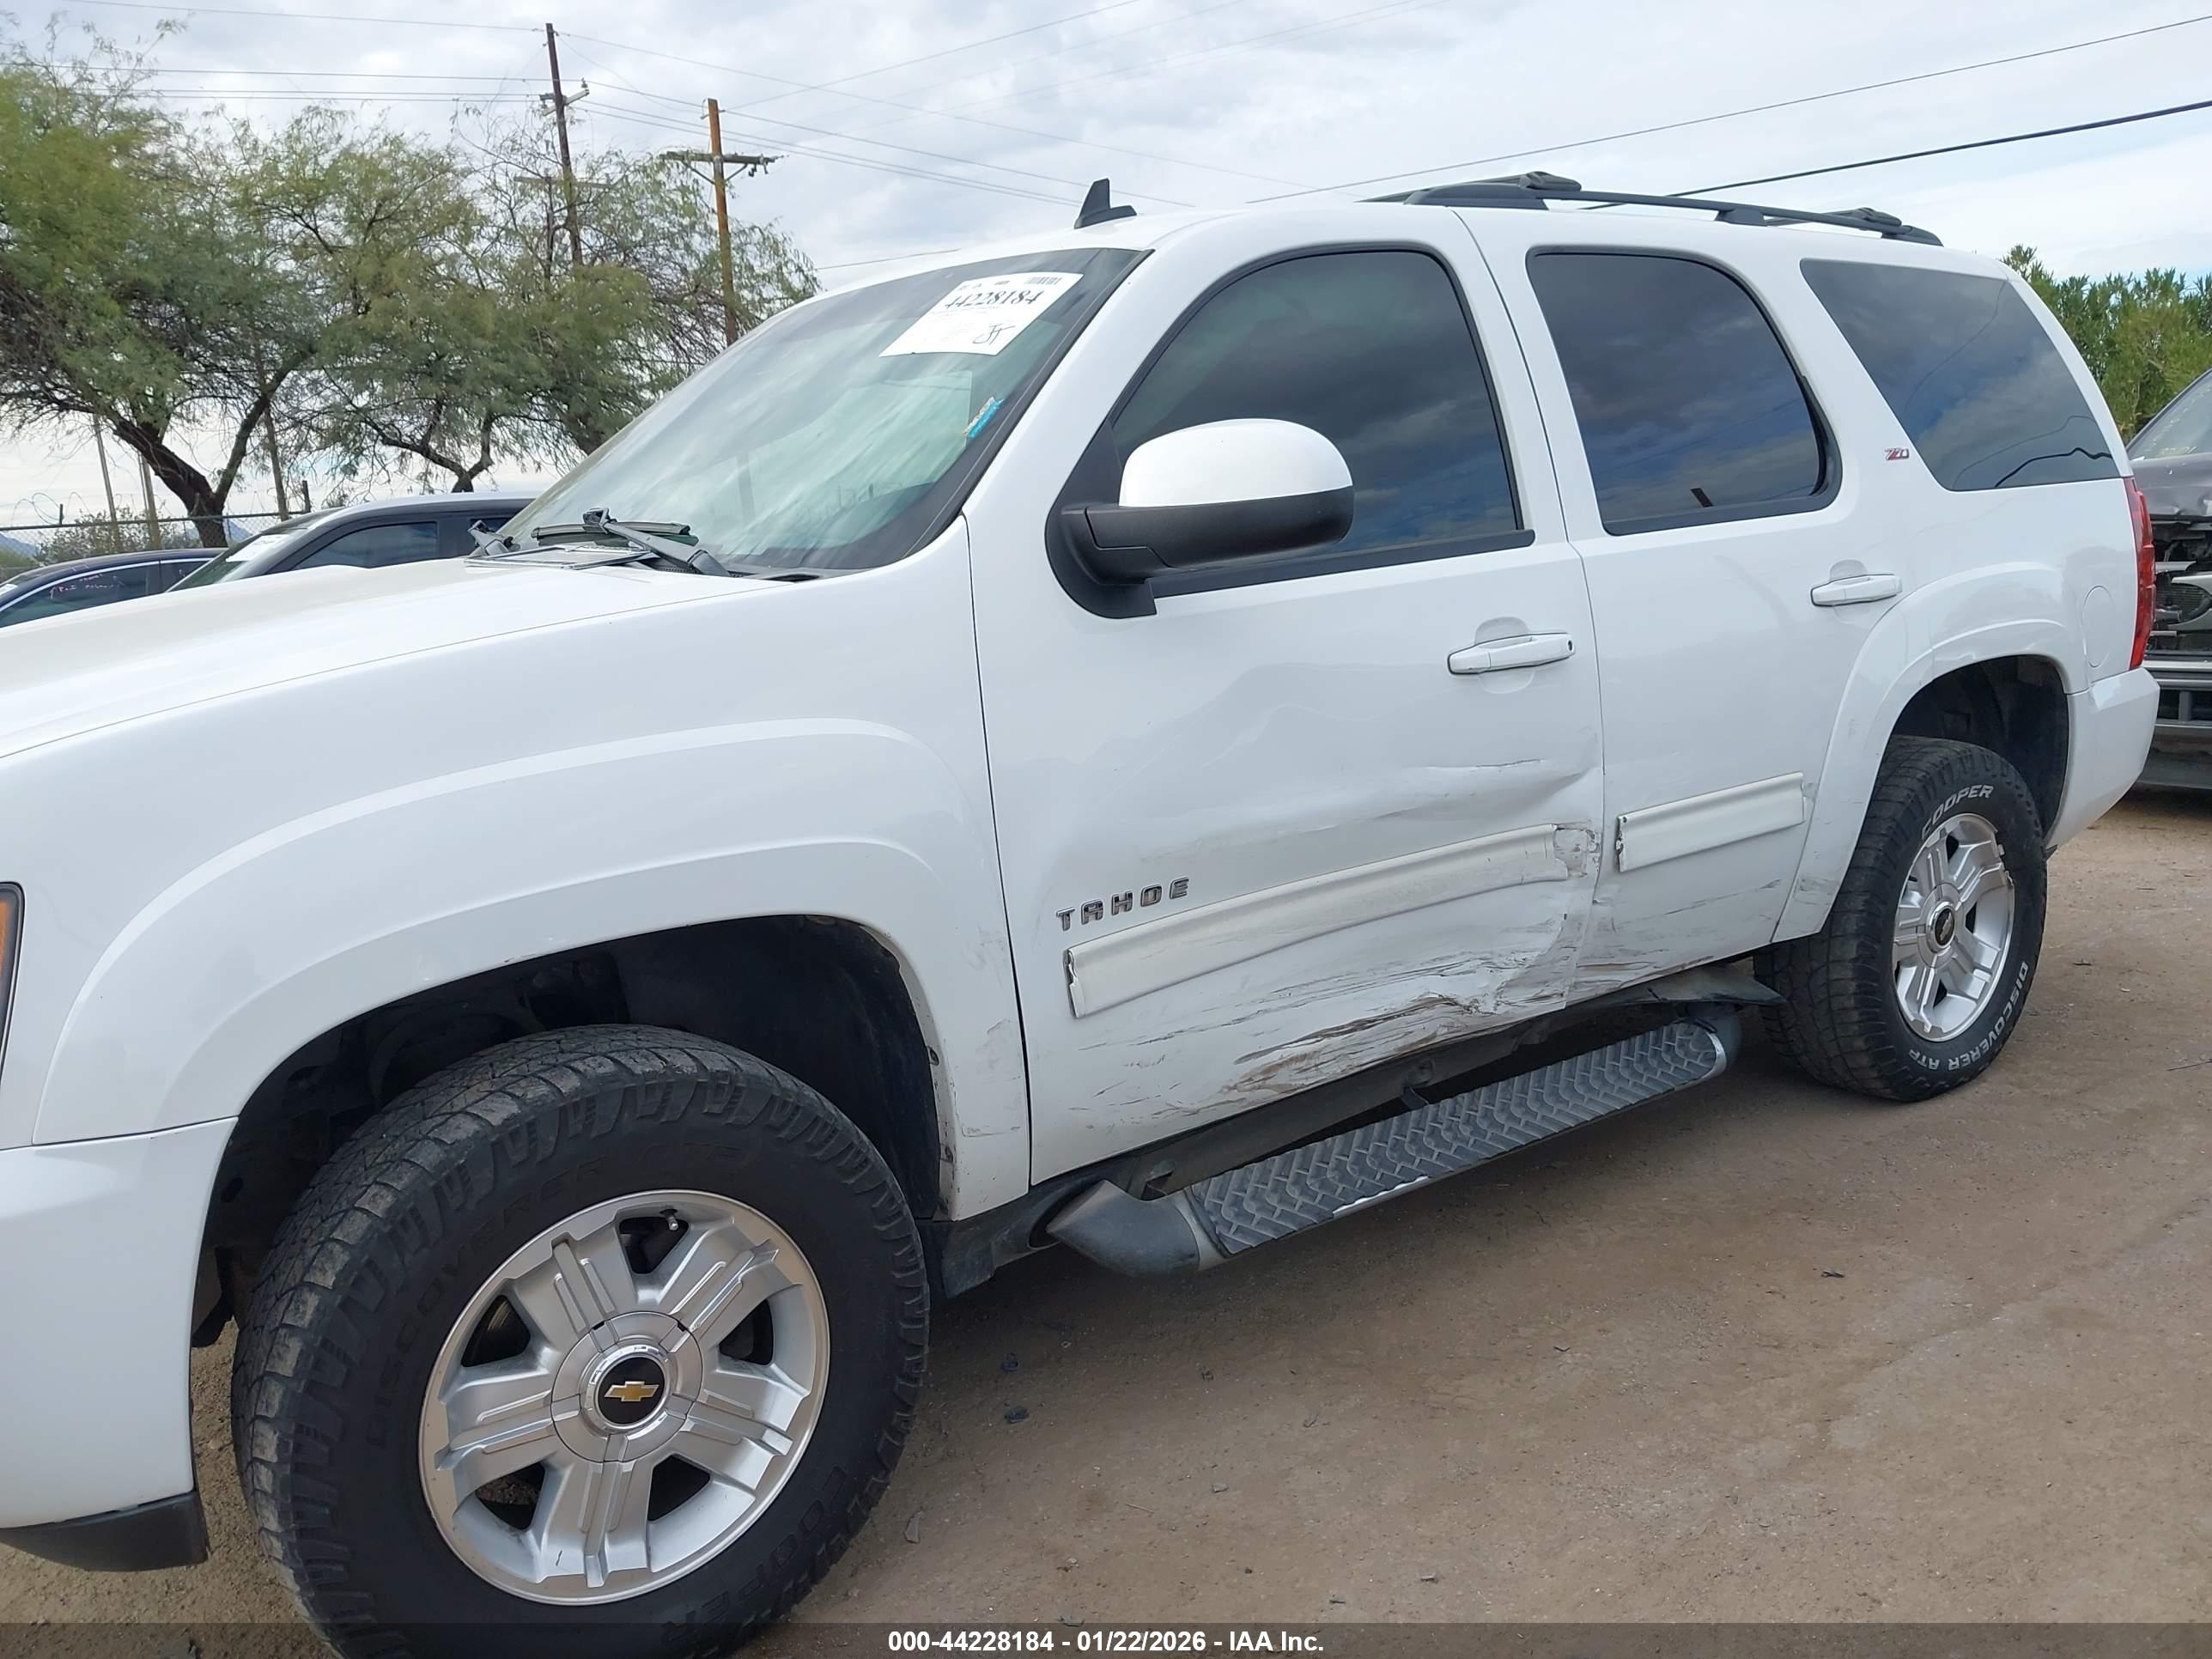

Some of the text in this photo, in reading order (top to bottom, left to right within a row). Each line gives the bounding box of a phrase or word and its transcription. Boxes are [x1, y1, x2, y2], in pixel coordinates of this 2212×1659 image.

[944, 289, 1045, 309] 44228184
[1921, 784, 1995, 841] COOPER
[1056, 877, 1189, 932] TAHOE
[1947, 961, 2029, 1072] DISCOVERER
